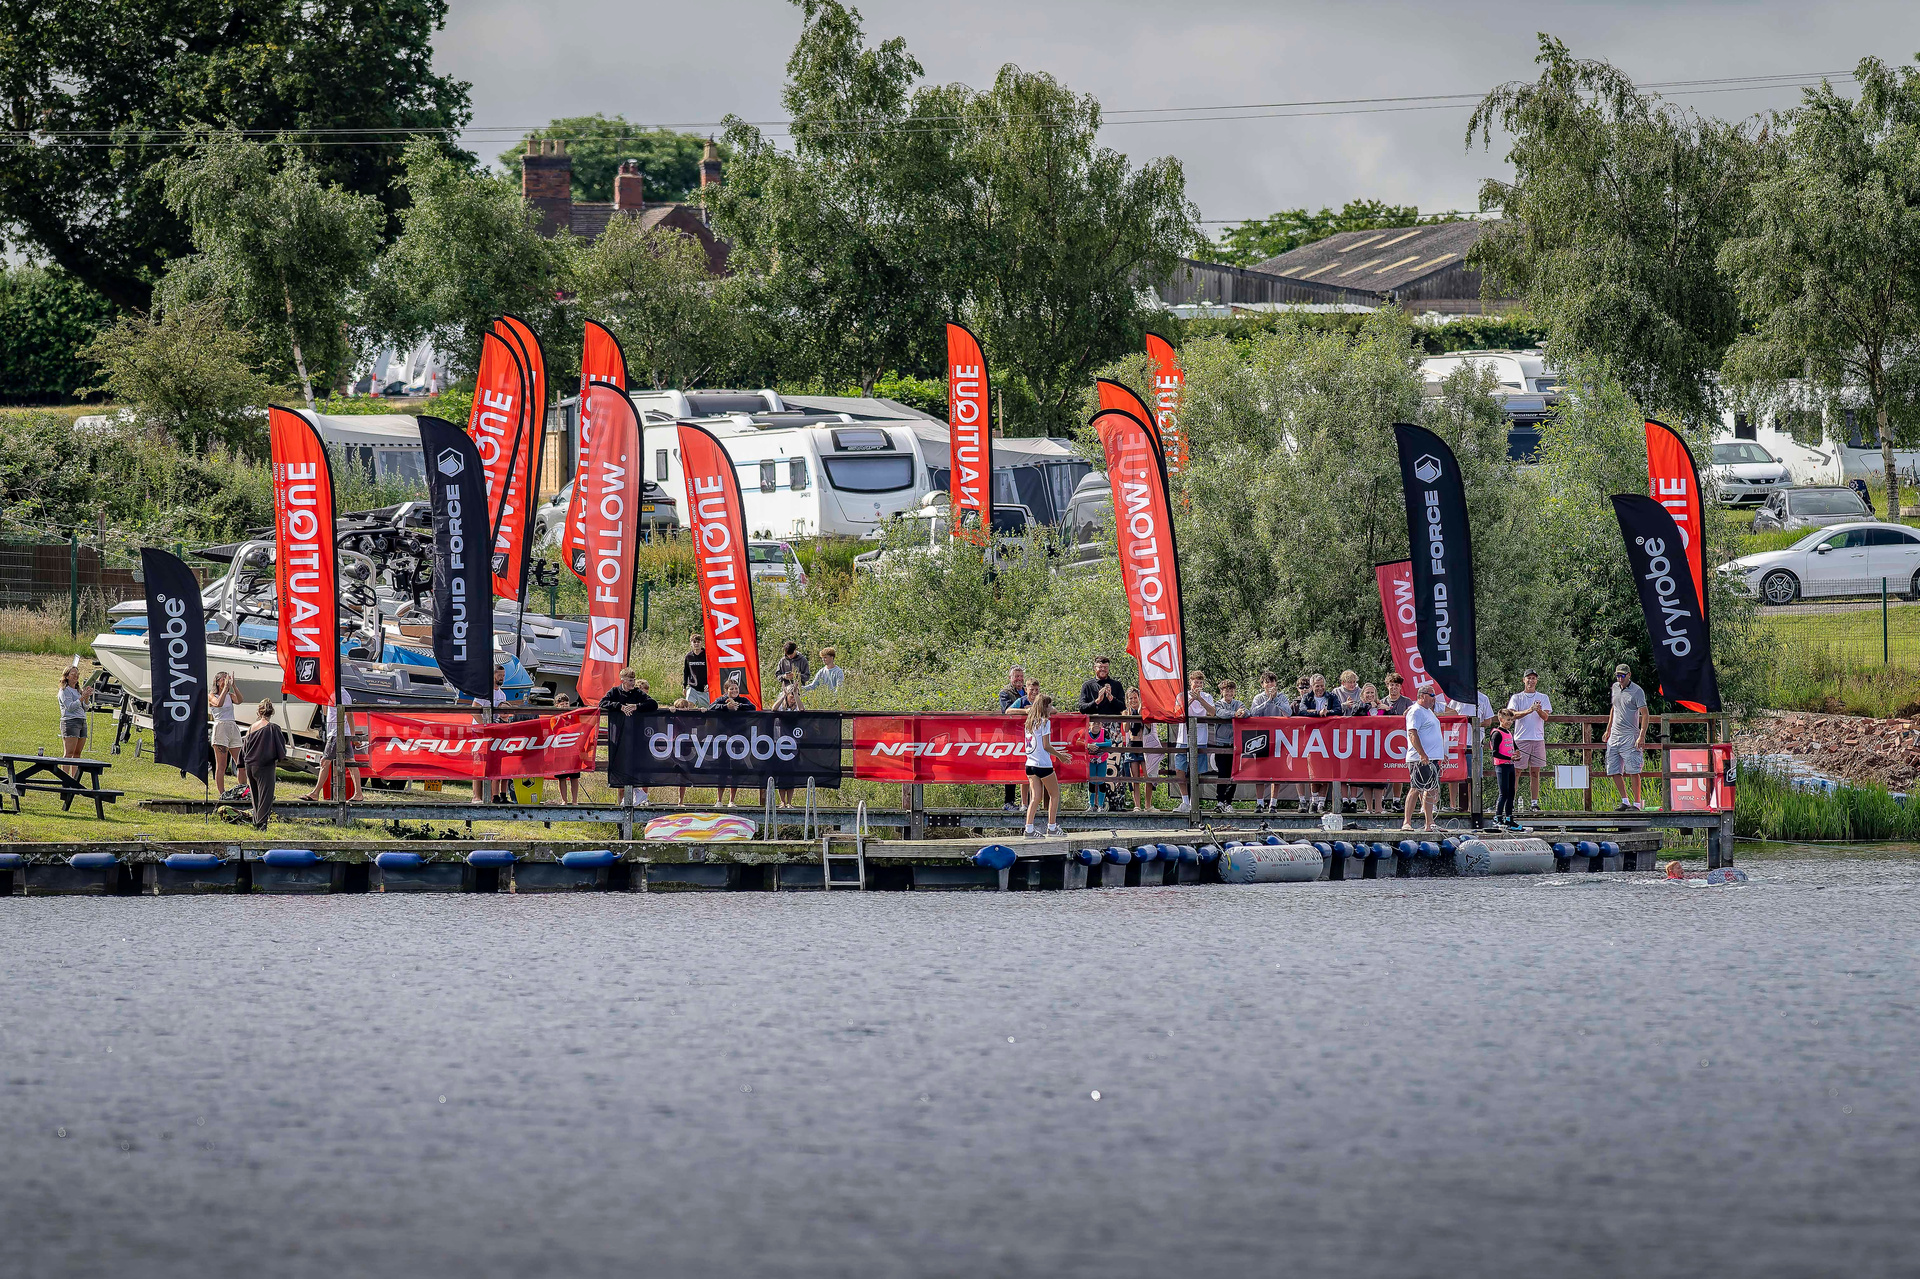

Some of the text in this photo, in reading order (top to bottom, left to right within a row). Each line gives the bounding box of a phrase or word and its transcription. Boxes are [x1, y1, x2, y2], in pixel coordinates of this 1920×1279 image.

[446, 484, 468, 661] LIQUID FORCE
[596, 454, 628, 603] FOLLOW.
[1124, 471, 1166, 622] FOLLOW.
[1424, 490, 1452, 666] LIQUID FORCE
[156, 593, 198, 722] dryrobe®
[1636, 535, 1692, 658] dryrobe®
[384, 732, 583, 754] NAUTIQUE
[648, 724, 804, 768] dryrobe®
[1274, 728, 1460, 760] NAUTIQE
